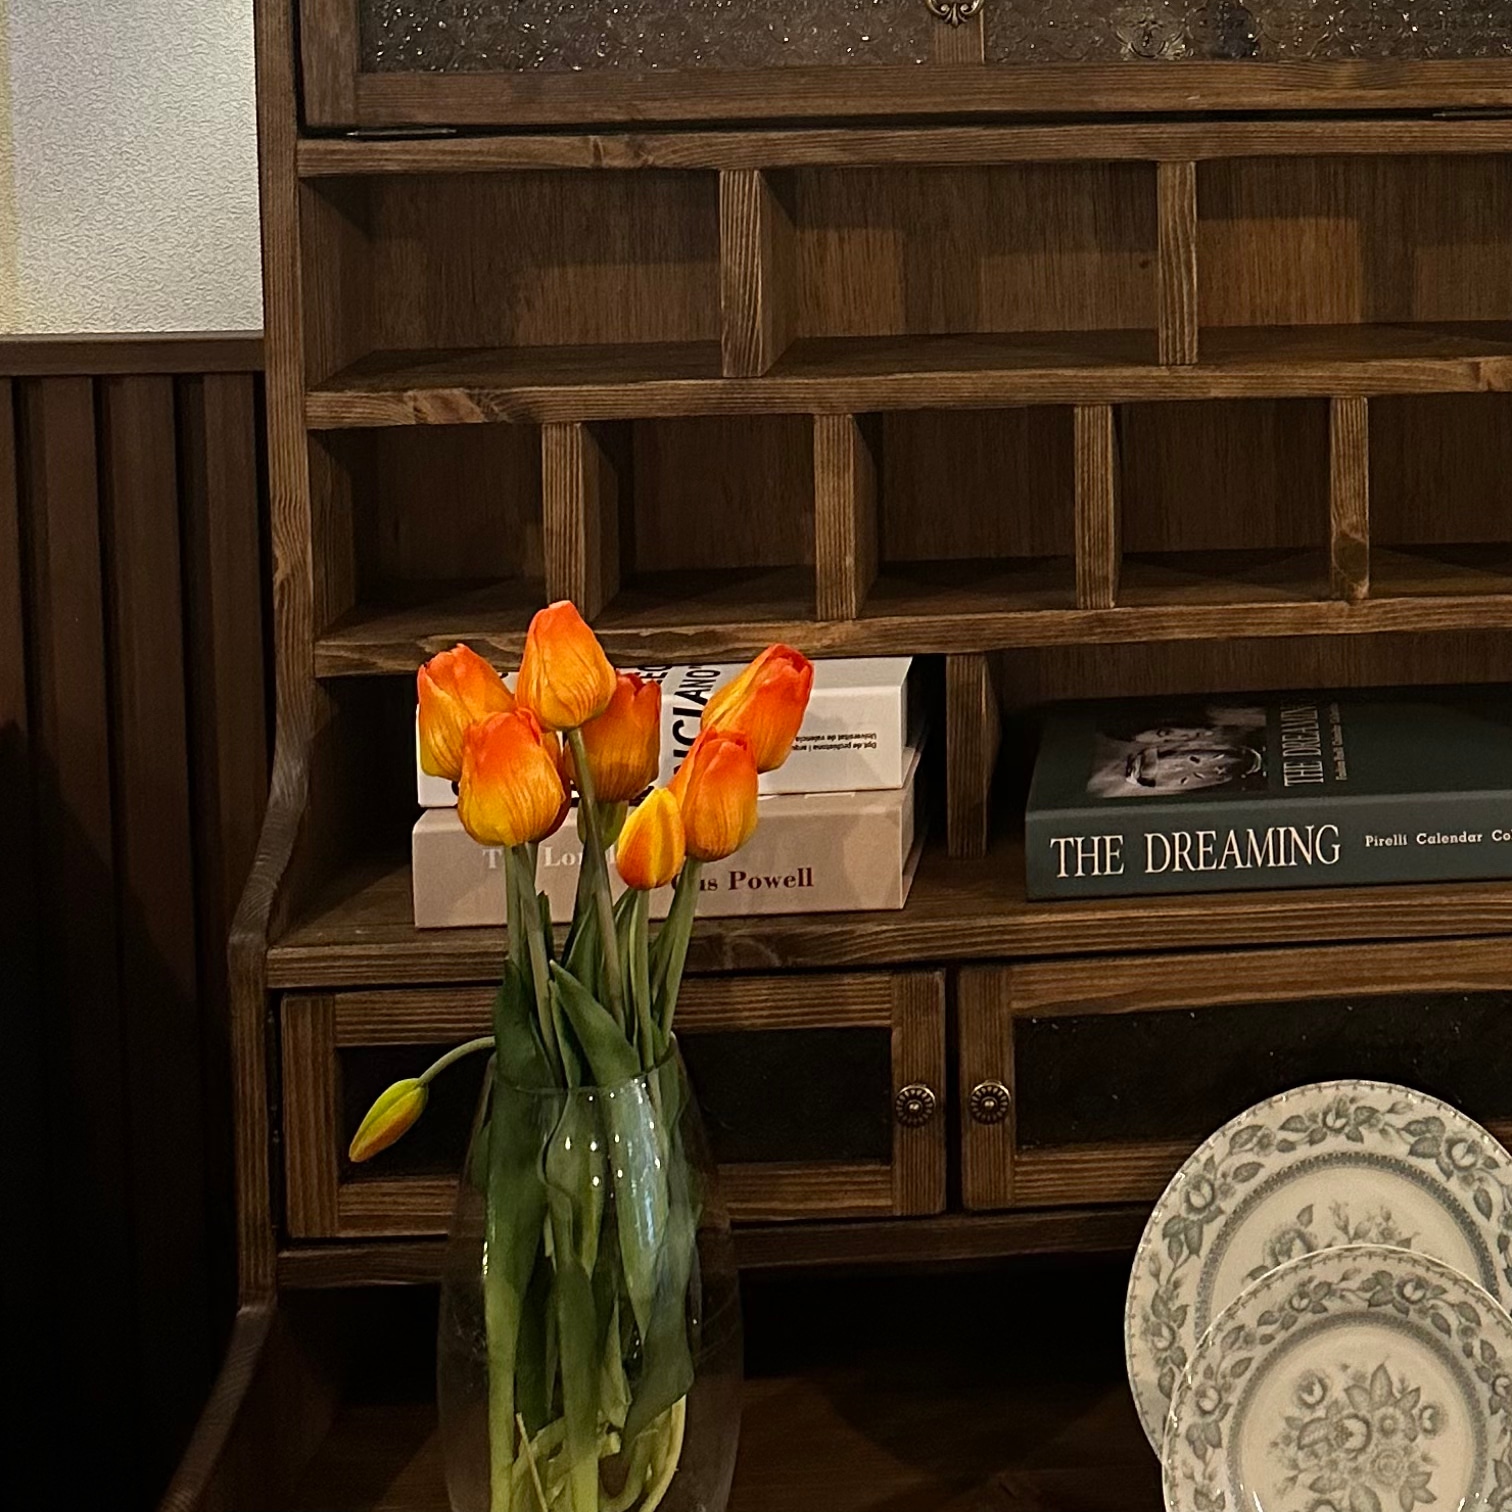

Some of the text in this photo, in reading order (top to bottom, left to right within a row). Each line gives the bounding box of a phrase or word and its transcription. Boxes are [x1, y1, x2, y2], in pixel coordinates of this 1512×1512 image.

[1283, 761, 1324, 786] THE
[1050, 835, 1125, 879] THE
[1143, 824, 1341, 875] DREAMING
[1365, 834, 1408, 848] Pirelli
[1416, 831, 1483, 845] Calendar
[728, 867, 814, 891] Powell
